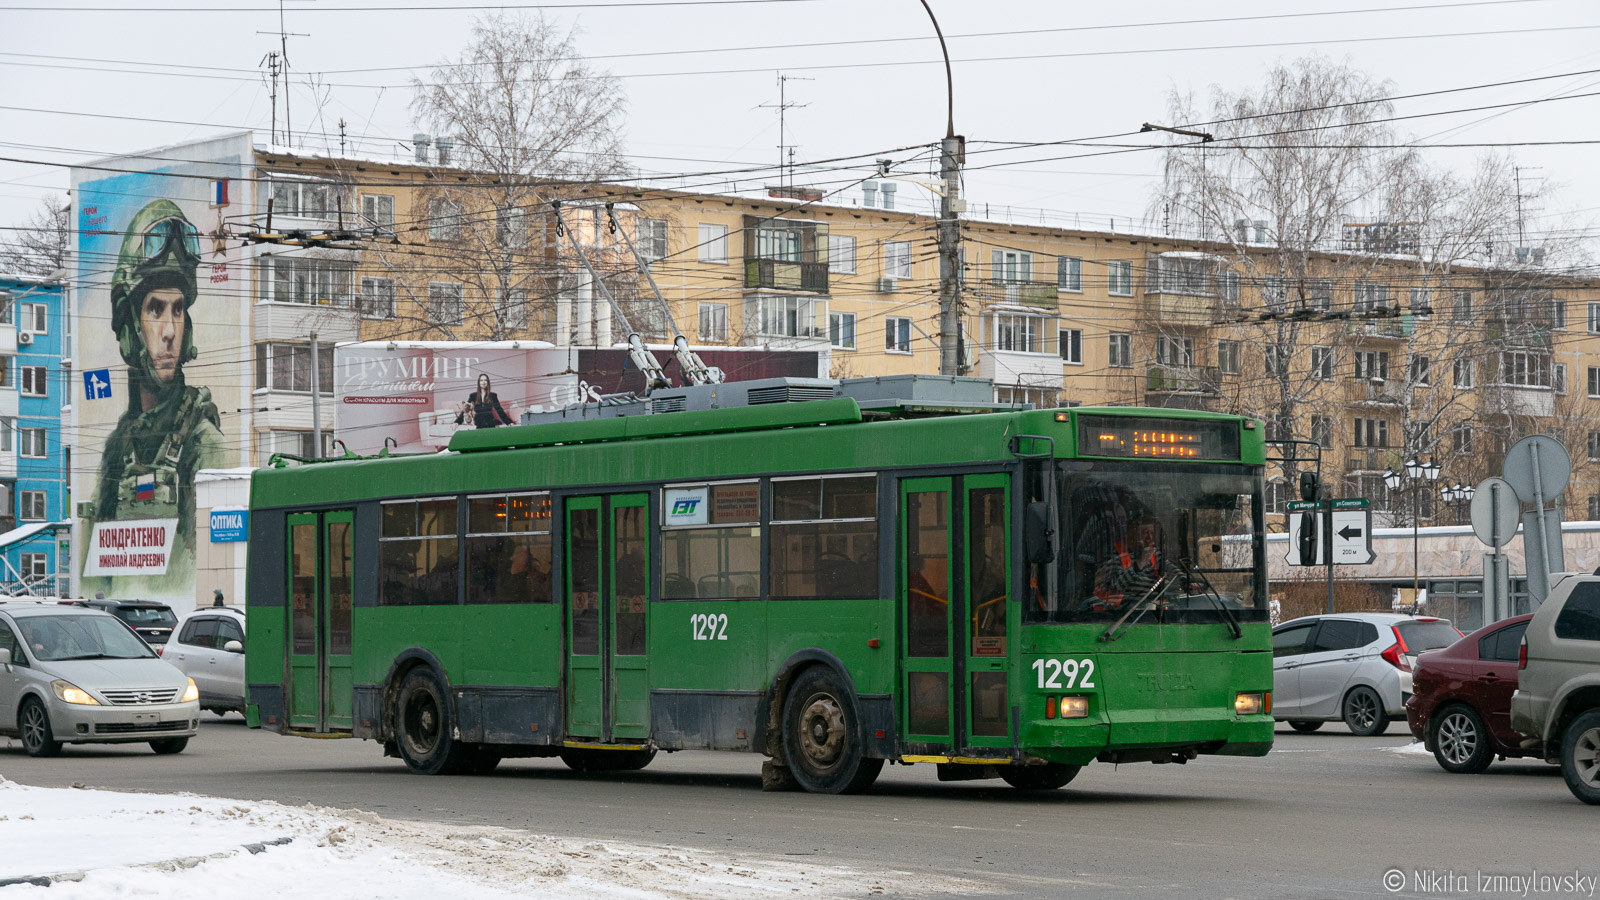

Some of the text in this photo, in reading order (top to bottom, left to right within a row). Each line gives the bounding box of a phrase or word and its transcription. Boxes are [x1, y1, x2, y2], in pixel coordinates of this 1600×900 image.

[343, 356, 480, 379] ГРУМИНГ
[211, 514, 243, 530] ОПТИКА
[98, 526, 166, 551] КОНДРАТЕНКО
[98, 552, 166, 569] НИКОЛАЙ АНДРЕЕВИЧ
[690, 613, 728, 641] 1292
[1031, 658, 1095, 689] 1292
